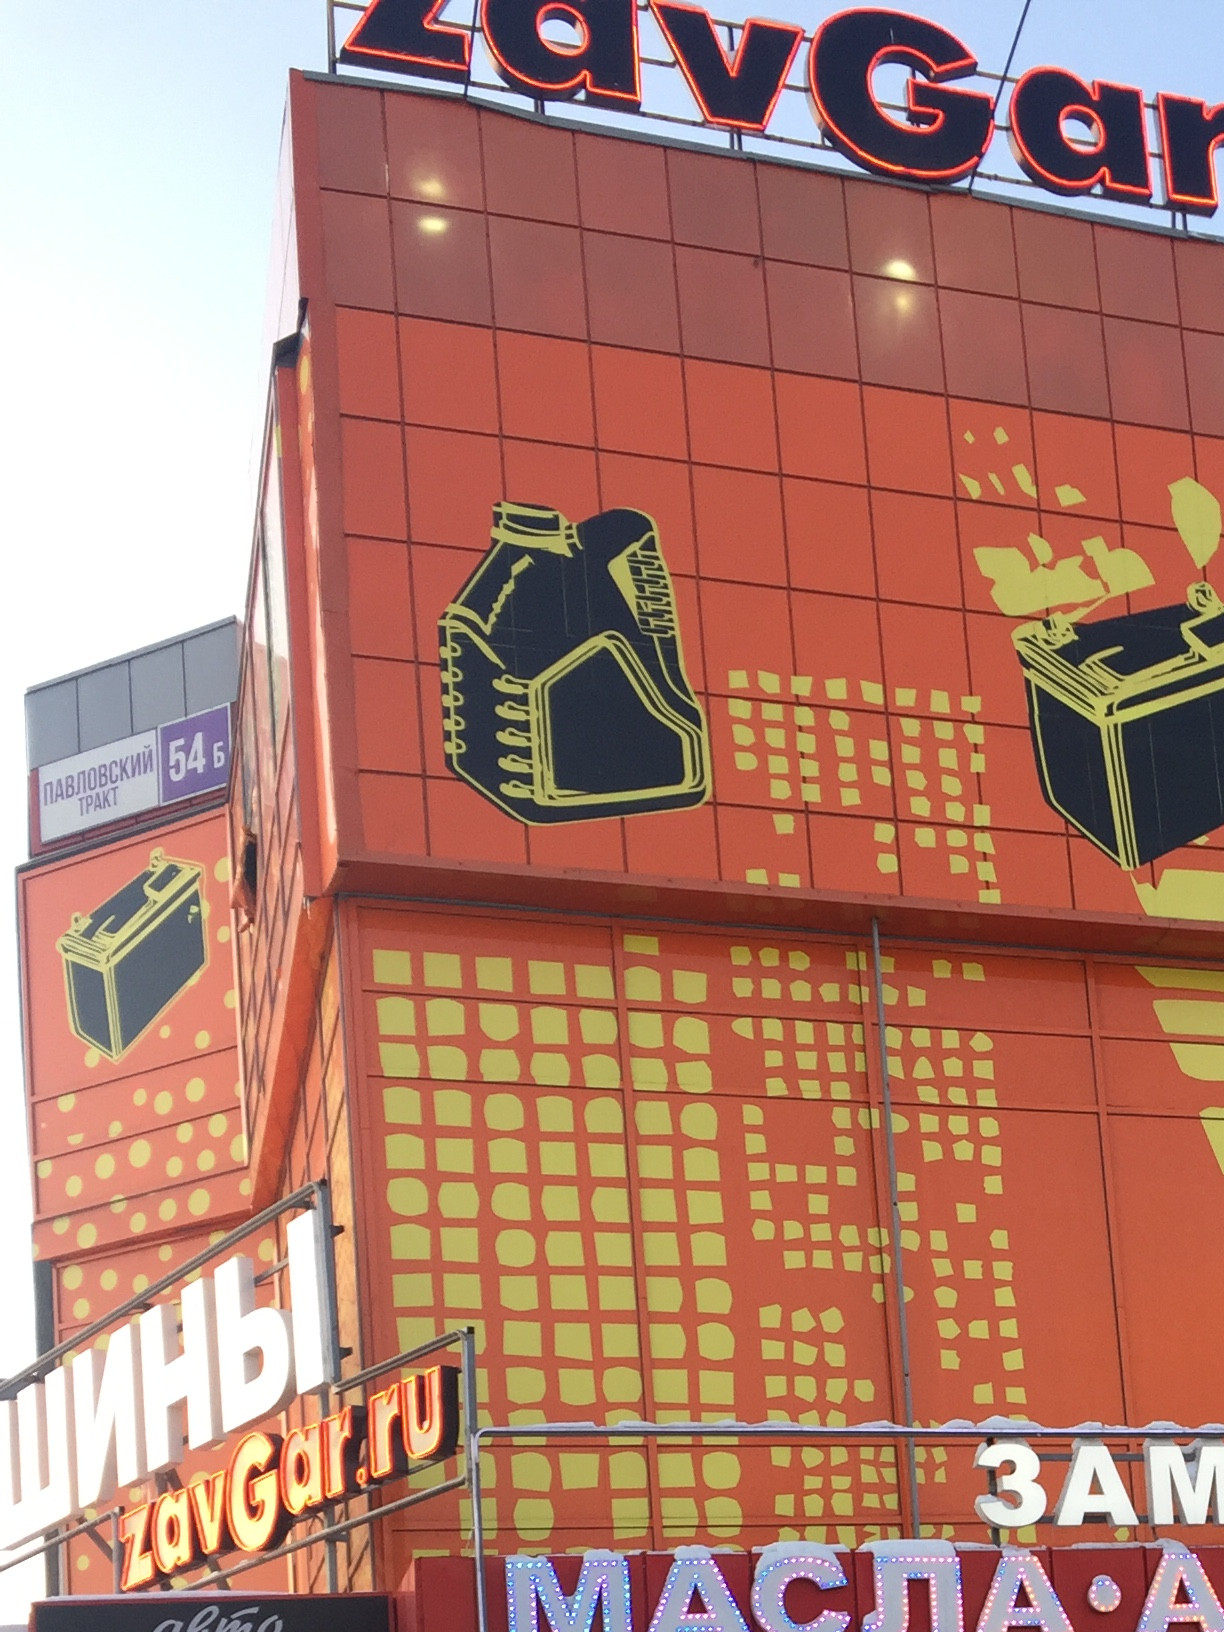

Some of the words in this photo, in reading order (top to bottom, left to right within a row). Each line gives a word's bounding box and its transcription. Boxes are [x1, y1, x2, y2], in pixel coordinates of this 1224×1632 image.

[44, 745, 153, 806] ПАВЛОВСКИЙ
[169, 731, 206, 782] 54
[78, 786, 120, 817] ТРАКТ
[0, 1209, 327, 1550] ШИНЫ
[119, 1365, 456, 1592] zavGar.ru
